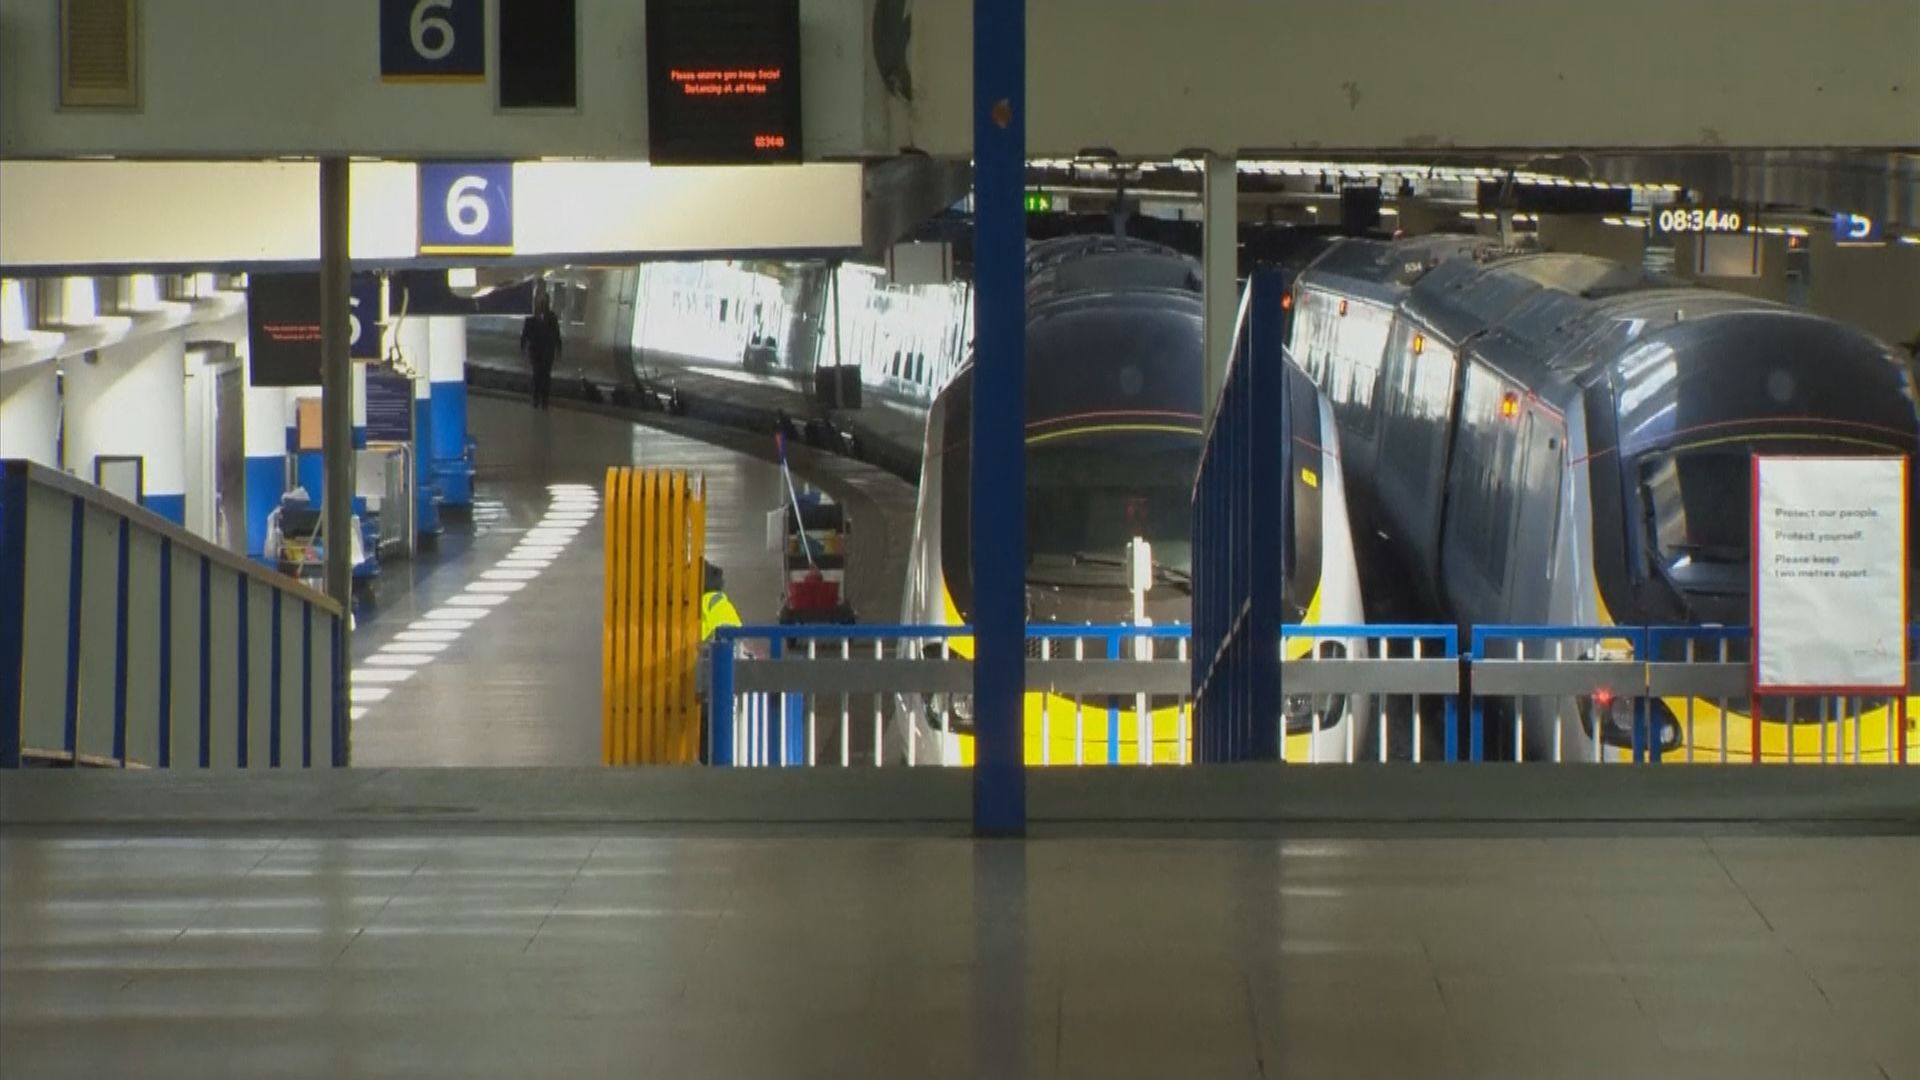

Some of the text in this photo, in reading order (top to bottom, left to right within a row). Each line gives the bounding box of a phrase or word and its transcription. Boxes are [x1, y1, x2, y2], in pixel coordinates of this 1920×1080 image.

[410, 0, 455, 59] 6
[671, 69, 695, 81] Please
[696, 71, 722, 80] ensure
[723, 71, 737, 81] you
[738, 69, 757, 81] keep
[724, 83, 734, 94] at
[735, 83, 745, 94] all
[746, 83, 766, 94] times
[447, 176, 489, 235] 6
[1775, 507, 1815, 518] Protect
[1775, 530, 1815, 540] Protect
[1775, 554, 1840, 565] Please keep
[1775, 569, 1795, 578] two
[1798, 569, 1836, 577] metres
